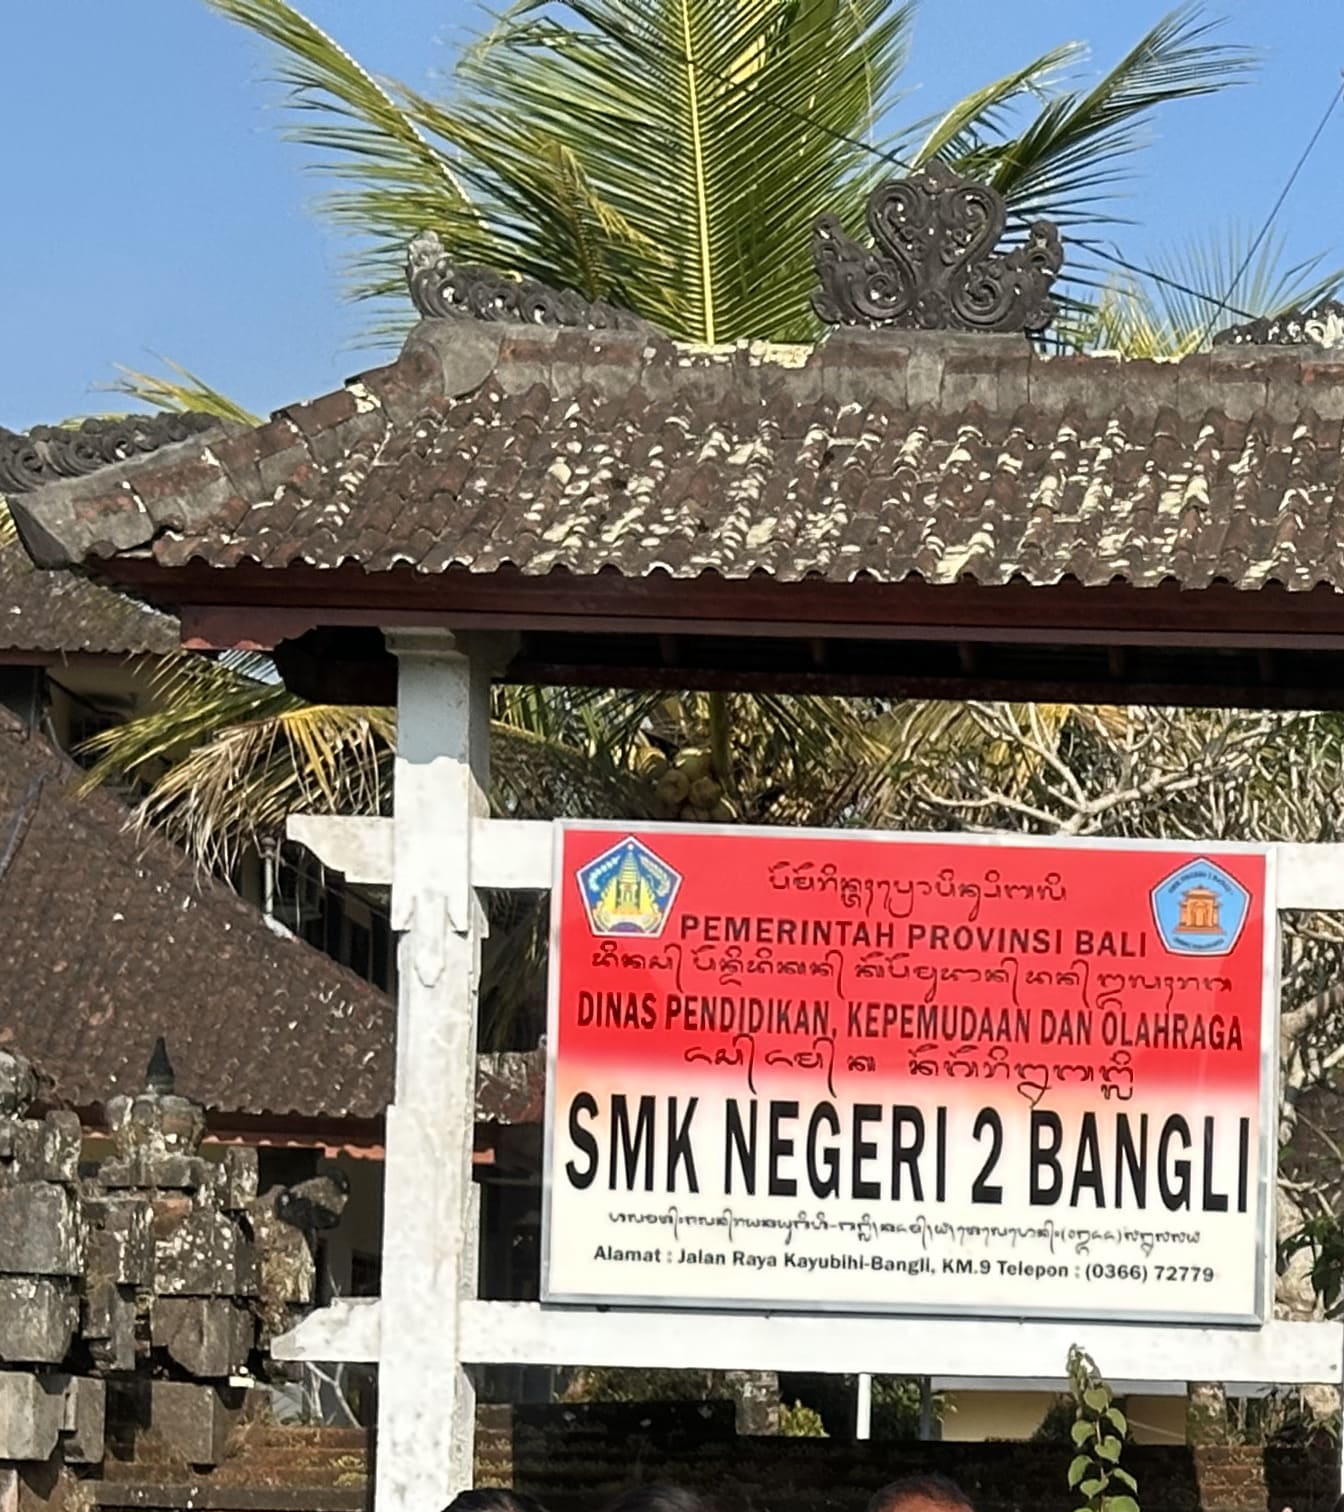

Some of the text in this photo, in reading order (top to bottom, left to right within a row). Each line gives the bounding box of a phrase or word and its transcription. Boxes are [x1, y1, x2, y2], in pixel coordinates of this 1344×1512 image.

[680, 914, 895, 949] PEMERINTAH
[907, 924, 1063, 956] PROVINSI
[1074, 930, 1147, 959] BALI
[577, 991, 1244, 1052] DINAS PENDIDIKAN, KEPEMUDAAN DAN OLAHRAGA
[565, 1091, 1251, 1213] SMK NEGERI 2 BANGLI
[593, 1245, 661, 1263] Alamat
[677, 1248, 726, 1266] Jalan
[732, 1250, 778, 1271] Raya
[783, 1252, 936, 1277] Kayubihi-Bangli,
[942, 1258, 992, 1275] KM.9
[996, 1260, 1070, 1280] Telepon
[1085, 1263, 1149, 1284] (0366)
[1154, 1265, 1215, 1283] 72779
